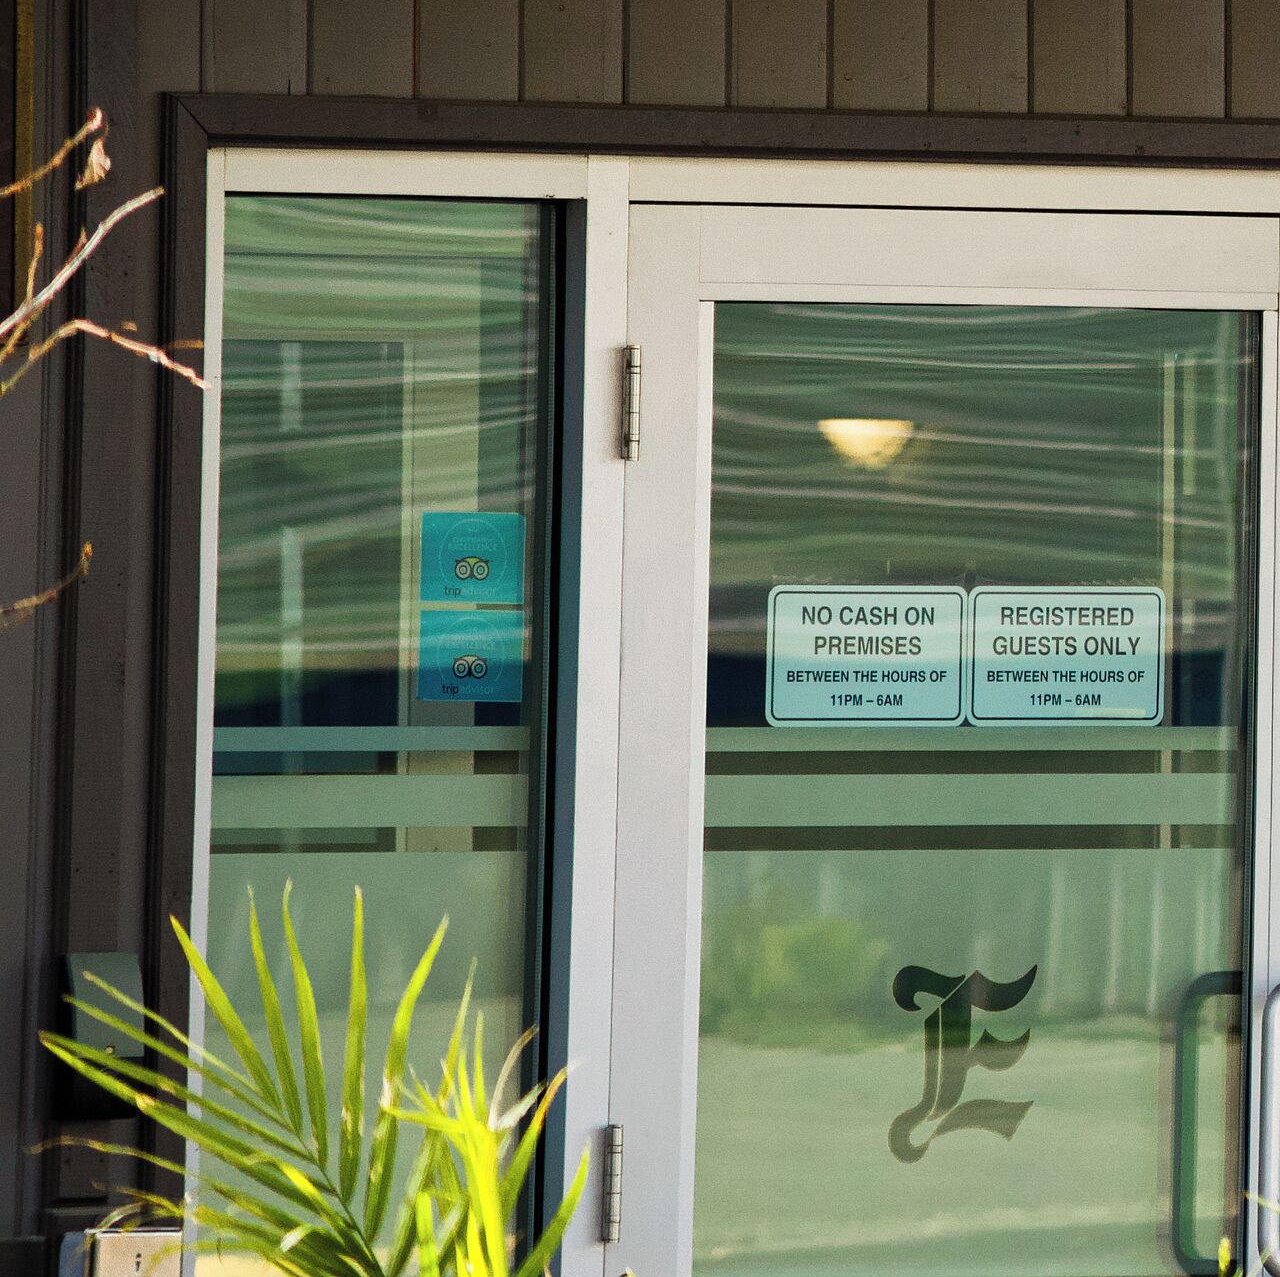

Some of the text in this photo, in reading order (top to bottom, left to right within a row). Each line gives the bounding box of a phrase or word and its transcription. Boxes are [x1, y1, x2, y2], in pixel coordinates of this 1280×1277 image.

[802, 606, 935, 625] NO CASH ON
[1000, 607, 1134, 626] REGISTERED
[814, 636, 922, 655] PREMISES
[992, 636, 1141, 655] GUESTS ONLY
[787, 670, 947, 682] BETWEEN THE HOURS OF
[987, 670, 1145, 682] BETWEEN THE HOURS OF
[830, 694, 863, 706] 11PM
[876, 694, 903, 706] 6AM
[1030, 694, 1062, 706] 11PM
[1075, 694, 1101, 706] 6AM
[888, 964, 1037, 1164] E
